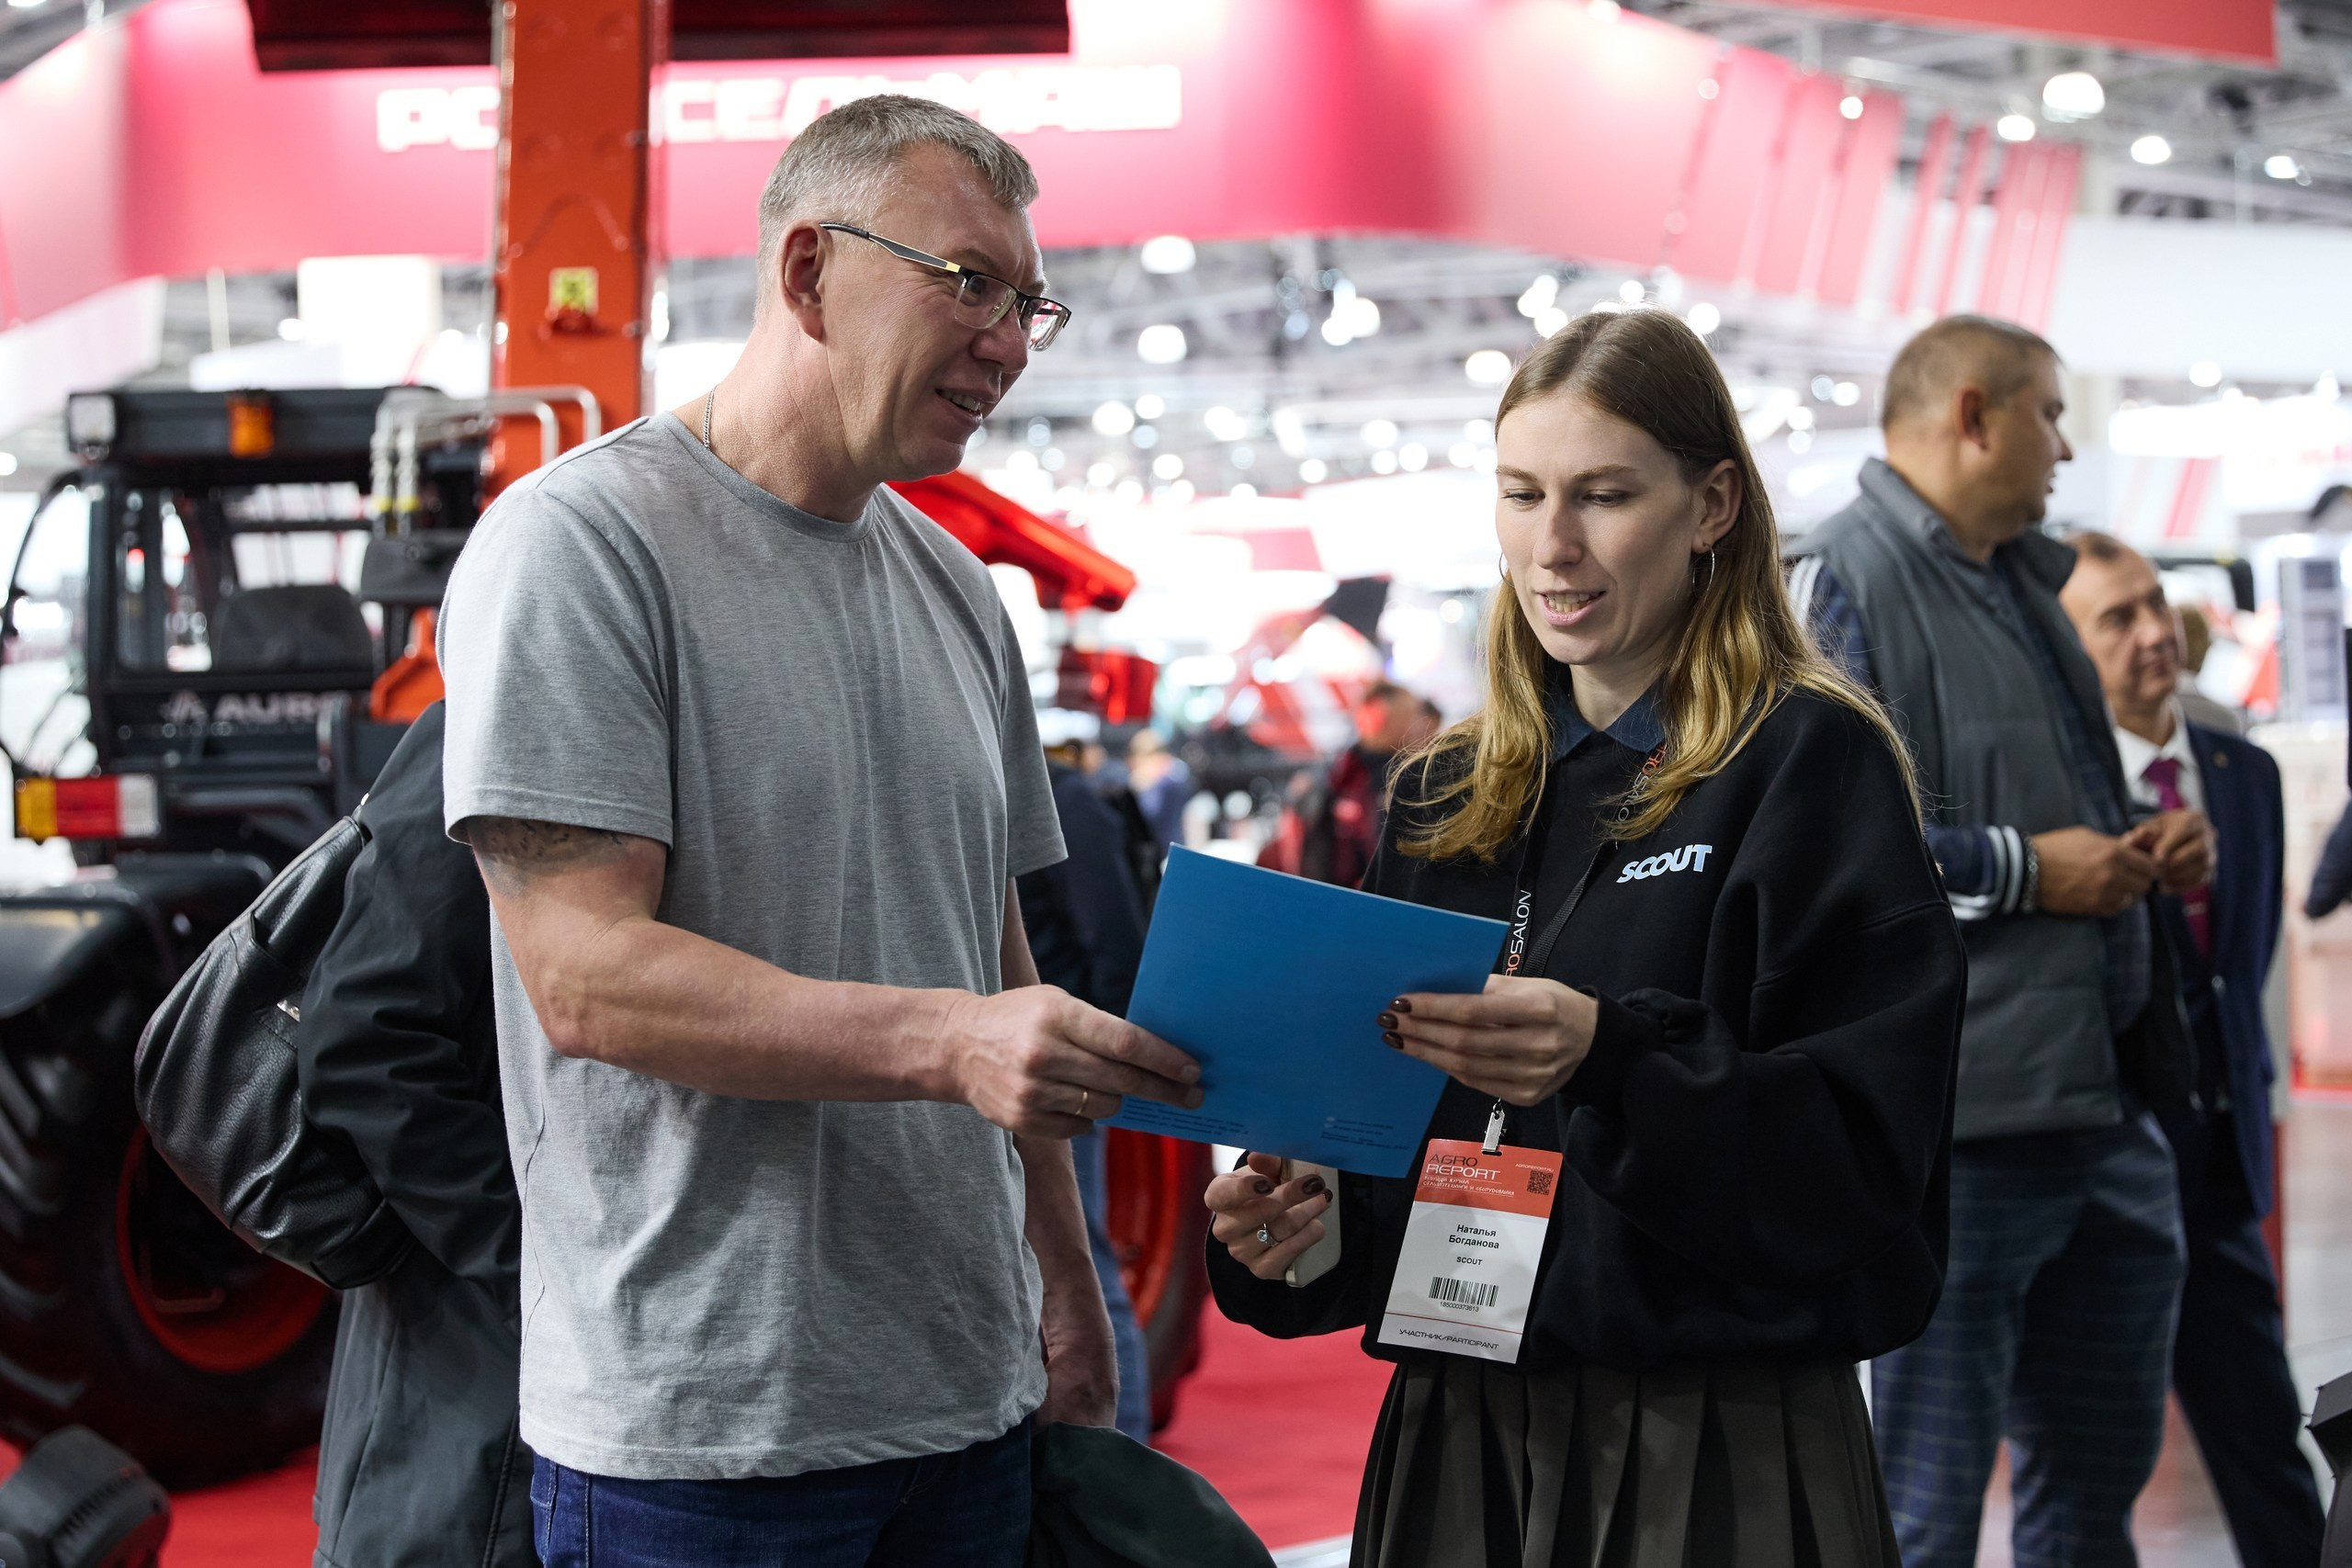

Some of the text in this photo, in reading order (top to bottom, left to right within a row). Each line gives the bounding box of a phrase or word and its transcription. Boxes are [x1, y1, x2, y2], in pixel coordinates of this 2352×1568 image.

[1616, 844, 1713, 884] SCOUT
[1429, 1154, 1478, 1167] AGRO
[1426, 1164, 1501, 1179] REPORT
[1456, 1224, 1497, 1237] Наталья
[1448, 1235, 1499, 1249] Богданова
[1456, 1256, 1483, 1266] SCOUT
[1399, 1328, 1499, 1349] УЧАСТНИК/PARTICIPANT
